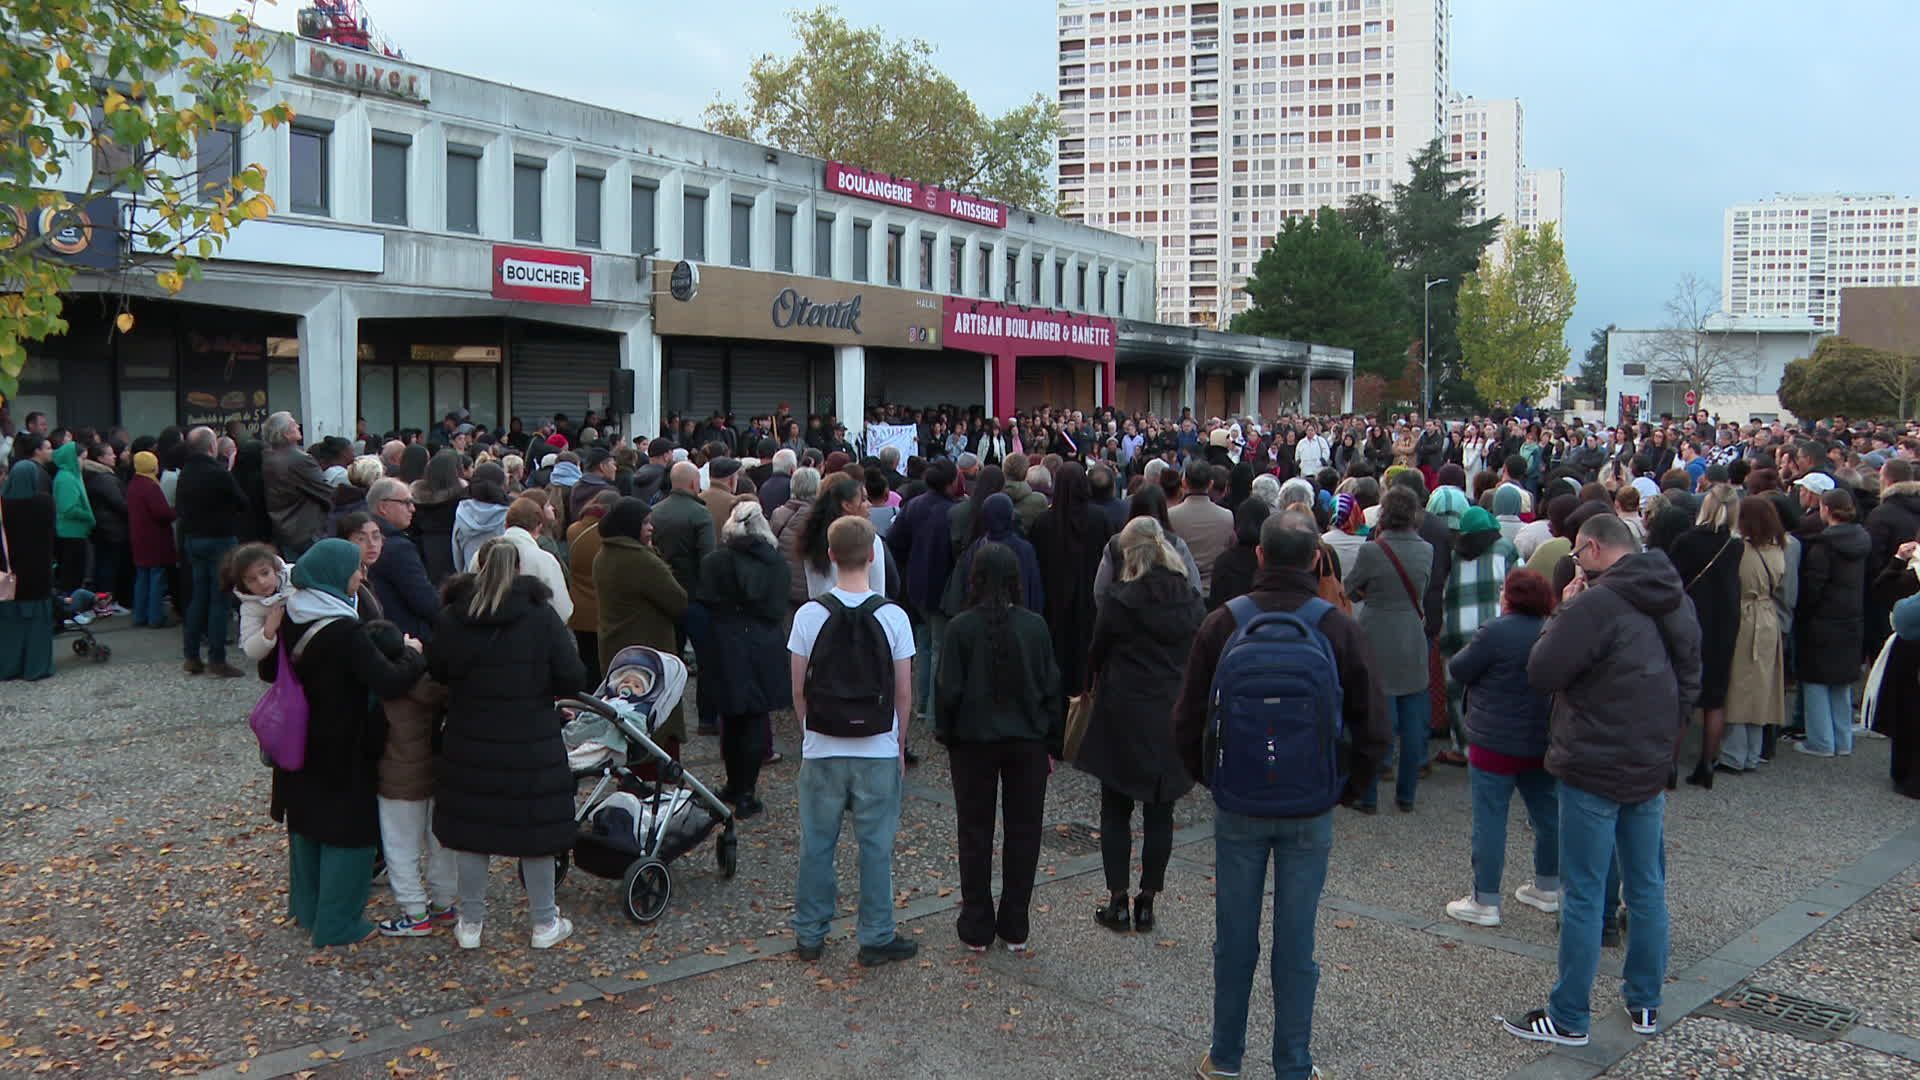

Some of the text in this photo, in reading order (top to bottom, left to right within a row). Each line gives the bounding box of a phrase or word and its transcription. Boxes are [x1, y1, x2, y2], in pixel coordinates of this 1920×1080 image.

[838, 171, 999, 223] BOULANGERIE PATISSERIE
[507, 265, 580, 286] BOUCHERIE
[772, 287, 864, 335] Otentik
[954, 312, 1111, 346] ARTISAN BOULANGER & BANETTE
